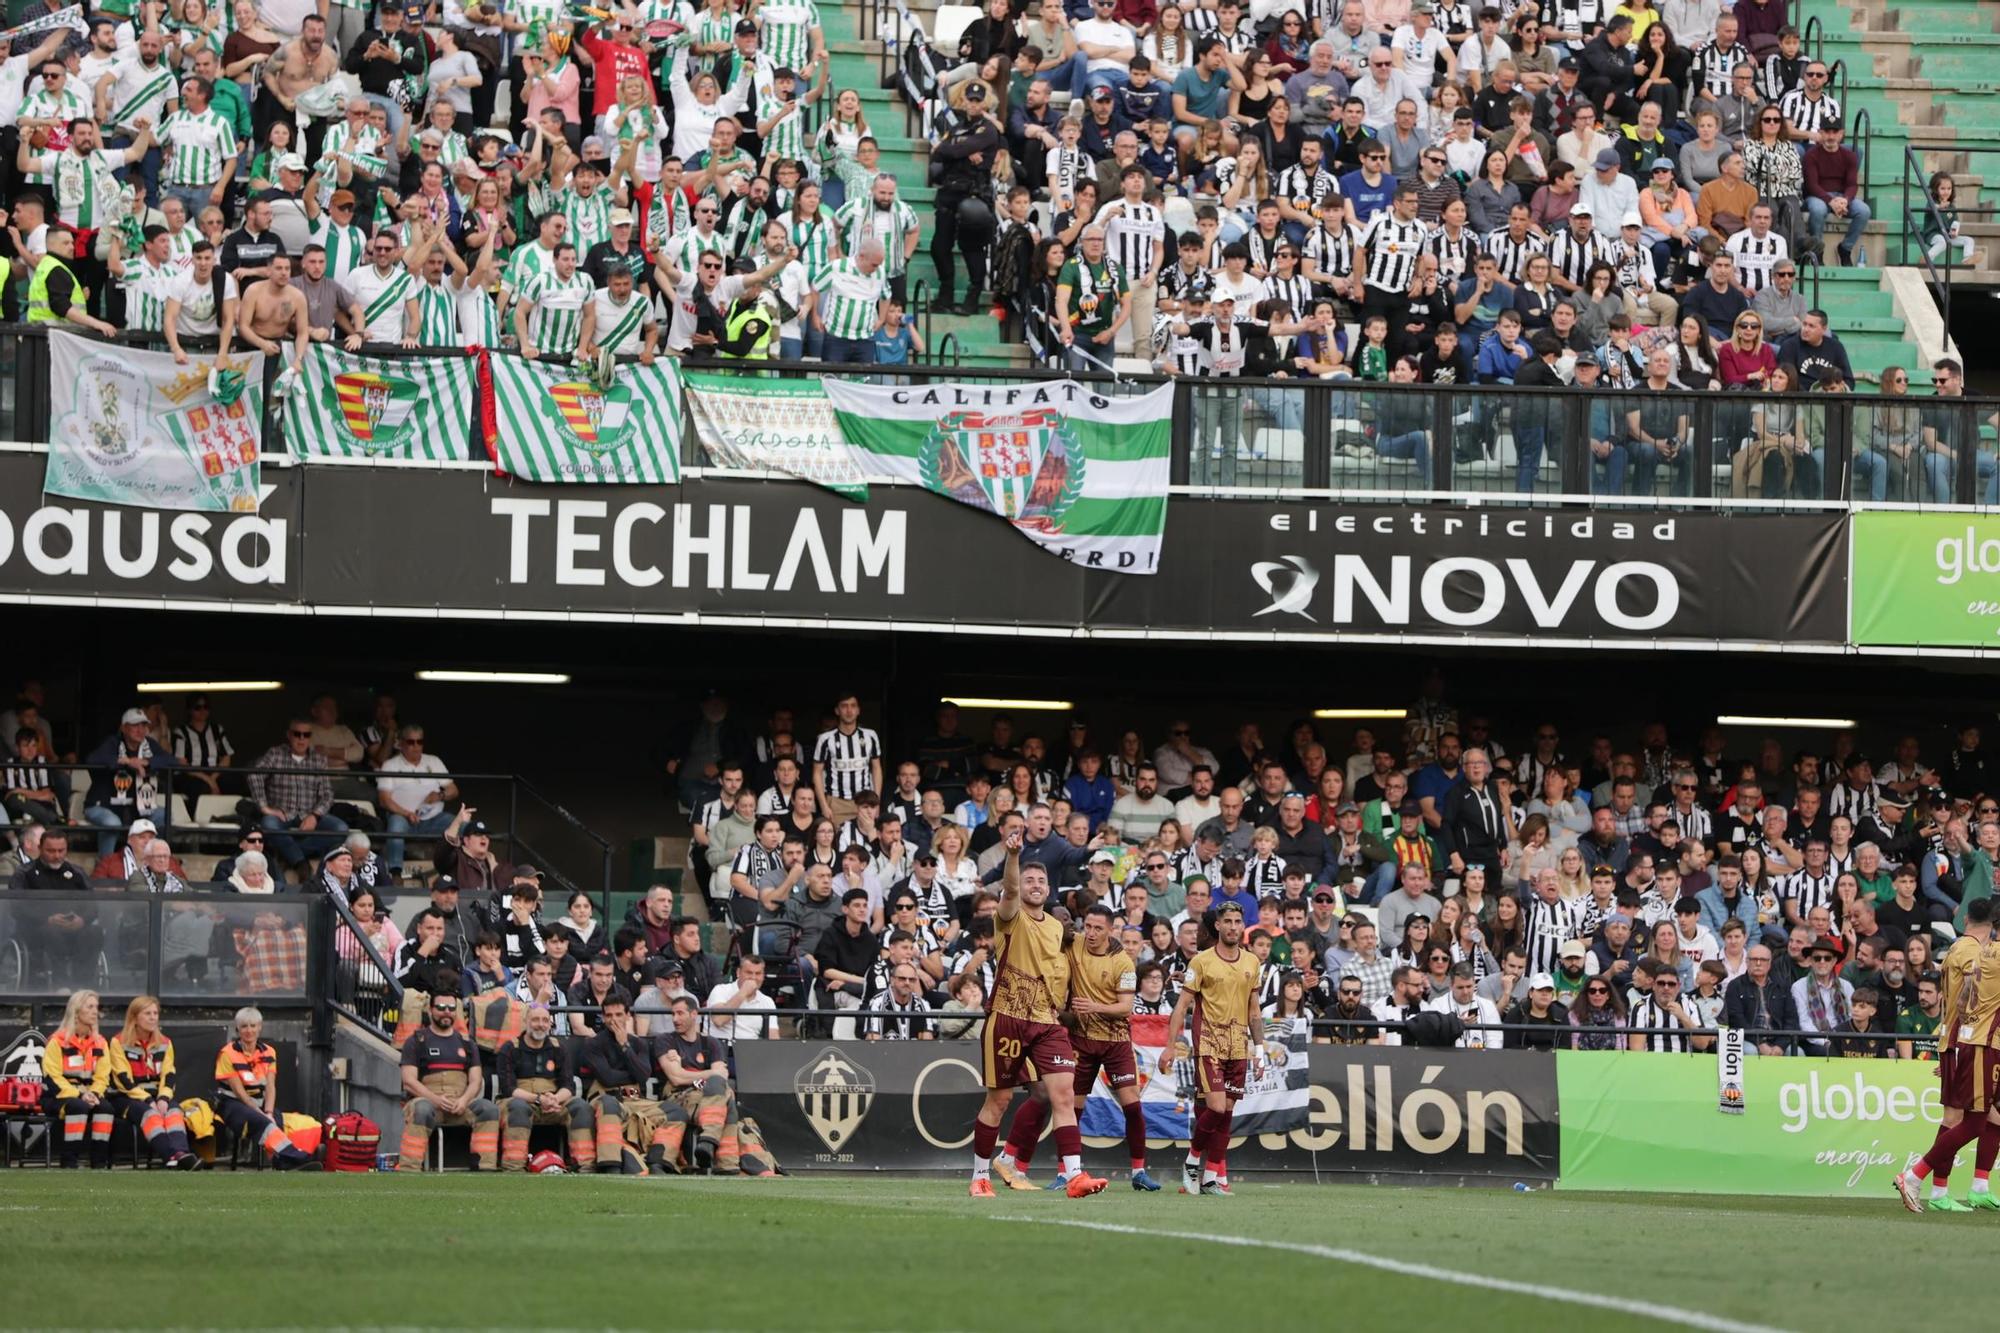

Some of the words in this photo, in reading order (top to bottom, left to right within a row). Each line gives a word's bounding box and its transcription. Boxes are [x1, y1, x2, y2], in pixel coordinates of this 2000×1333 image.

[891, 384, 1109, 410] CALIFATO
[1269, 509, 1676, 542] electricidad
[491, 497, 907, 596] TECHLAM
[1332, 554, 1681, 631] NOVO
[997, 1037, 1022, 1059] 20
[815, 1153, 831, 1163] 1922
[838, 1153, 854, 1163] 2022
[1815, 1140, 1896, 1188] energía
